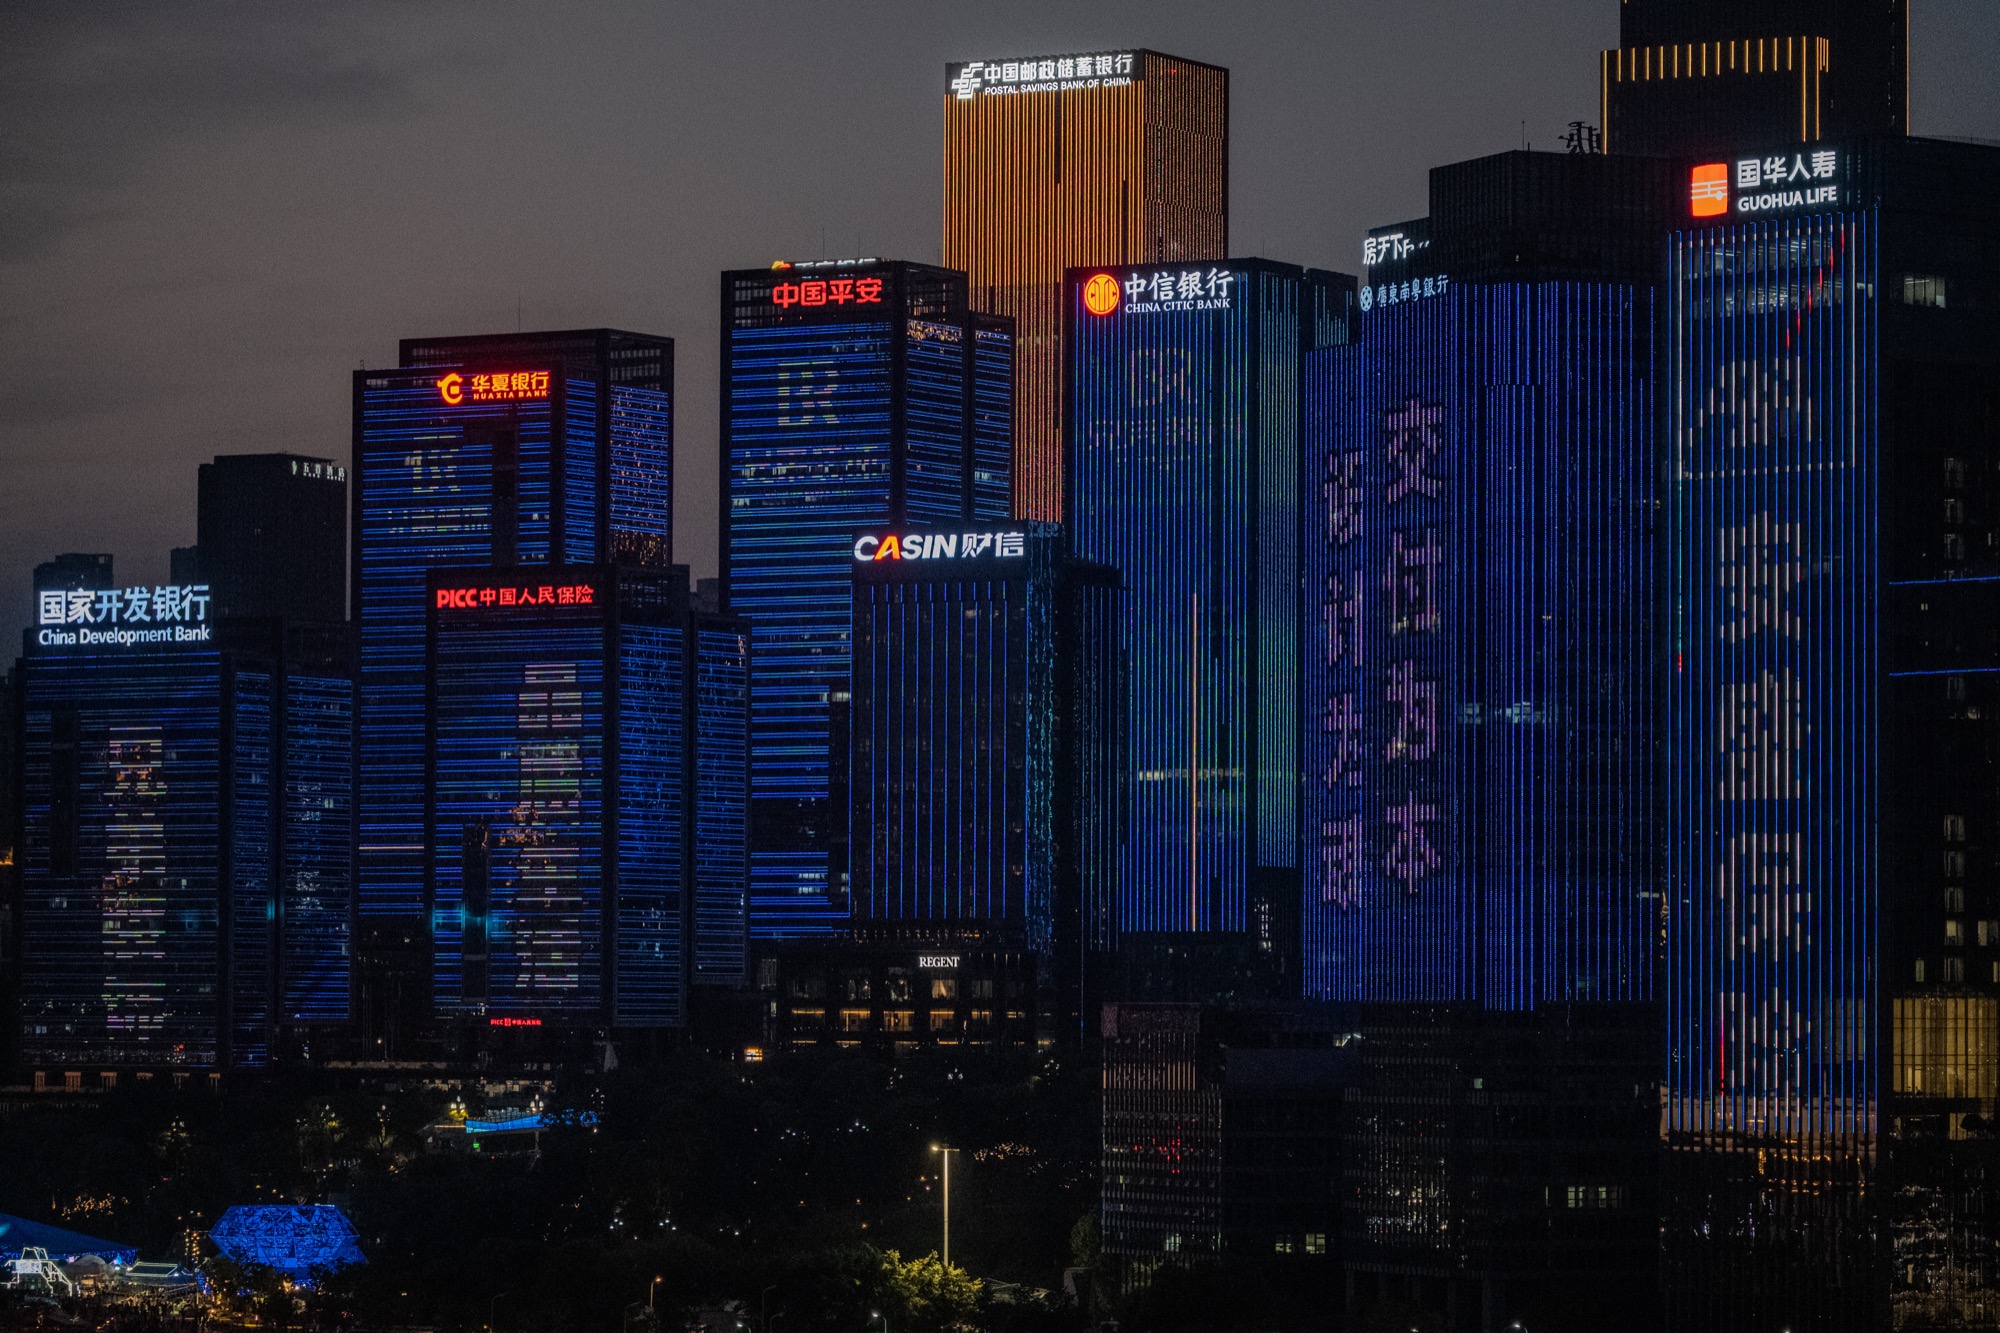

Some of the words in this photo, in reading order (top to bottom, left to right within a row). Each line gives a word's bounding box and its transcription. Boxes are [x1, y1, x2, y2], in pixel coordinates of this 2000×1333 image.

[984, 54, 1133, 84] 中国邮政储蓄银行
[984, 84, 1018, 96] POSTAL
[1020, 82, 1058, 94] SAVINGS
[1061, 80, 1085, 91] BANK
[1087, 79, 1100, 89] OF
[1103, 77, 1132, 88] CHINA
[1737, 151, 1836, 188] 国华人寿
[1738, 193, 1804, 212] GUOHUA
[1806, 187, 1837, 205] LIFE
[1363, 233, 1403, 266] 房天下
[773, 277, 883, 309] 中国平安
[1125, 267, 1234, 304] 中信银行
[1125, 301, 1161, 314] CHINA
[1163, 299, 1194, 312] CITIC
[1196, 298, 1231, 309] BANK
[471, 371, 549, 393] 华夏银行
[473, 391, 515, 400] HUAXIA
[518, 389, 548, 398] BANK
[854, 533, 958, 561] CASIN
[961, 531, 1025, 558] 财信
[39, 584, 210, 625] 国家开发银行
[436, 588, 477, 609] PICC
[479, 584, 595, 606] 中国人民保险
[38, 628, 76, 646] China
[79, 626, 172, 647] Development
[175, 624, 210, 642] Bank
[919, 956, 960, 968] REGENT
